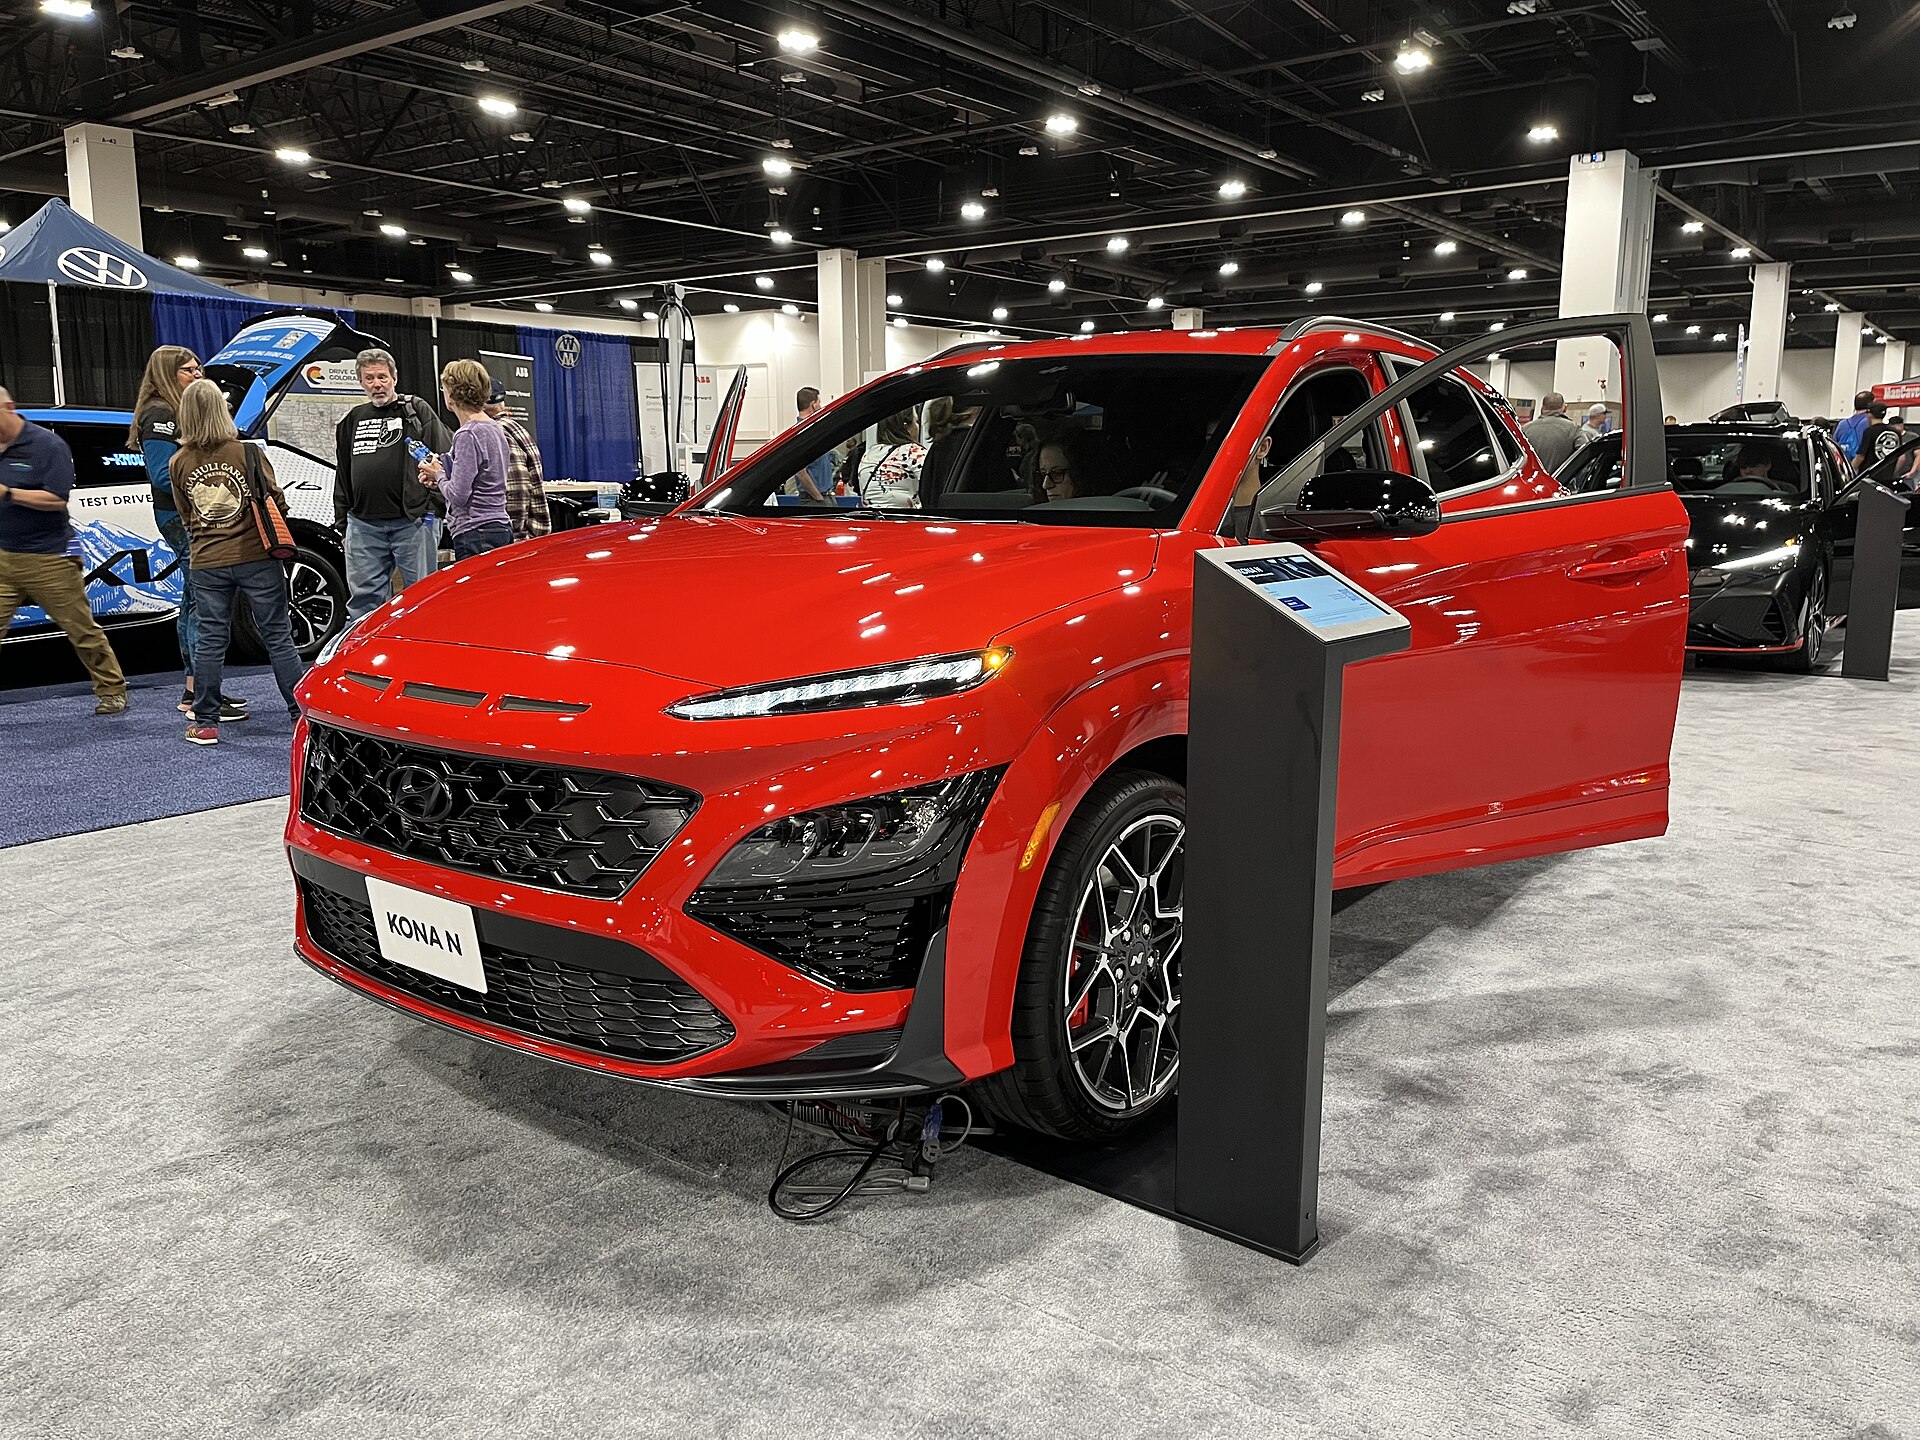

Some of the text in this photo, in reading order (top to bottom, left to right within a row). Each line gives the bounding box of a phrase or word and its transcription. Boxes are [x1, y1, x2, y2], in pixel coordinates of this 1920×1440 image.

[220, 462, 252, 497] GARDEN
[79, 494, 154, 507] TEST DRIVE
[386, 911, 463, 956] KONA N
